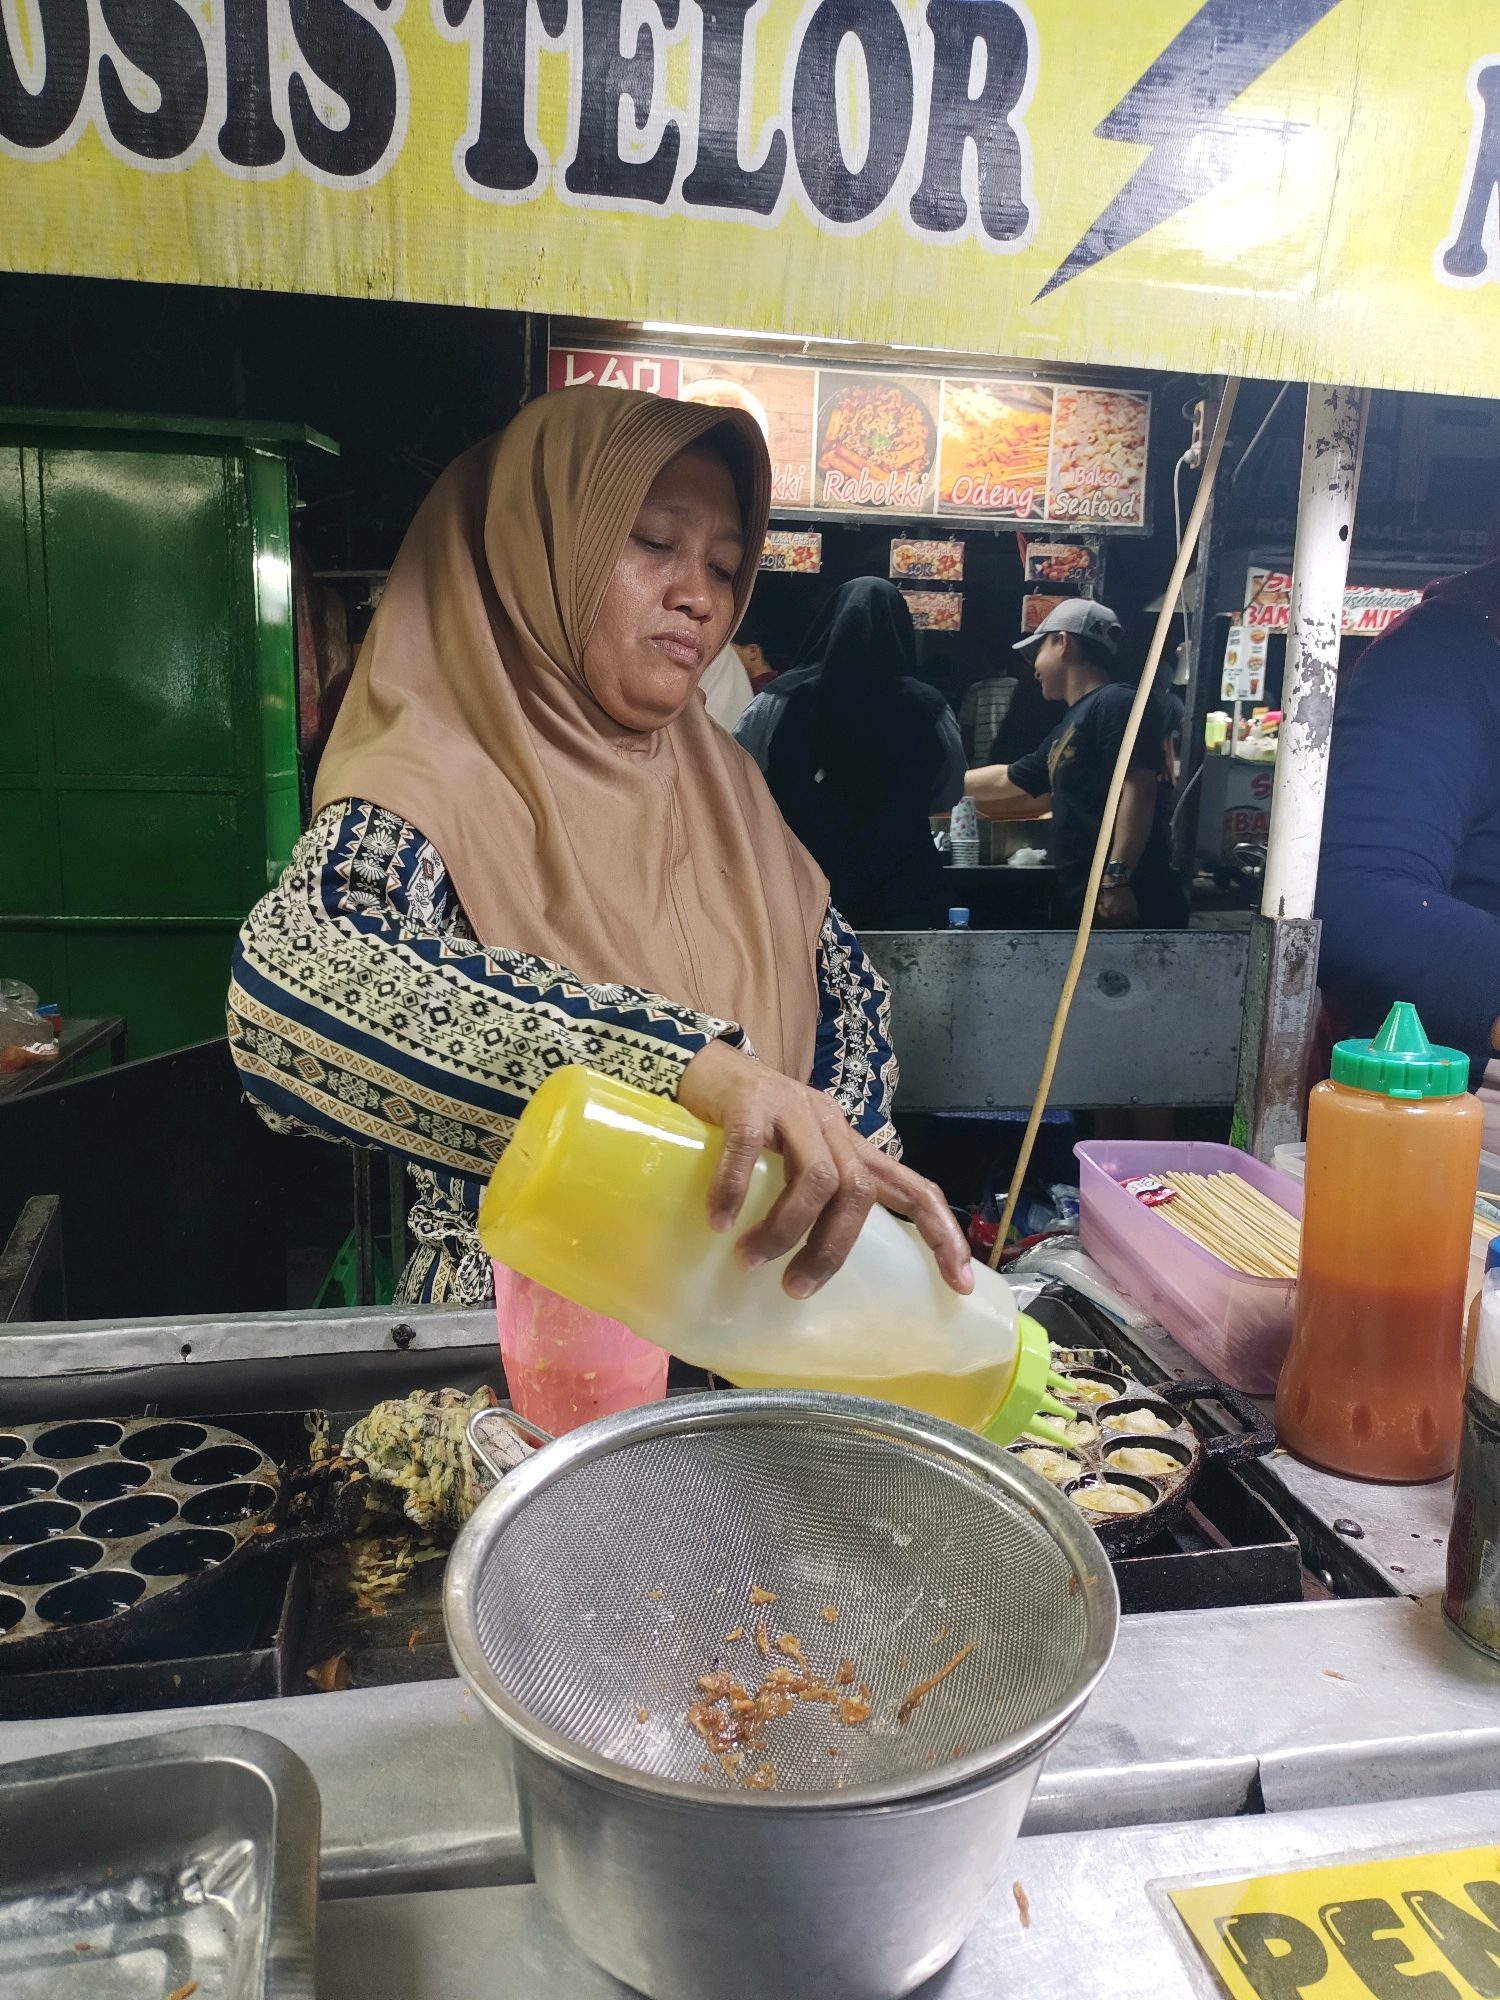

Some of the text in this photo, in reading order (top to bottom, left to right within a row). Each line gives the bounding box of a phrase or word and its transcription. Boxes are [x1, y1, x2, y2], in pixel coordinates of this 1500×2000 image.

[433, 0, 1031, 242] TELOR
[822, 467, 930, 507] Rabokki
[1073, 466, 1122, 488] Bakso
[952, 473, 1035, 519] Odeng
[1055, 491, 1137, 518] Seafood
[908, 564, 921, 576] 10
